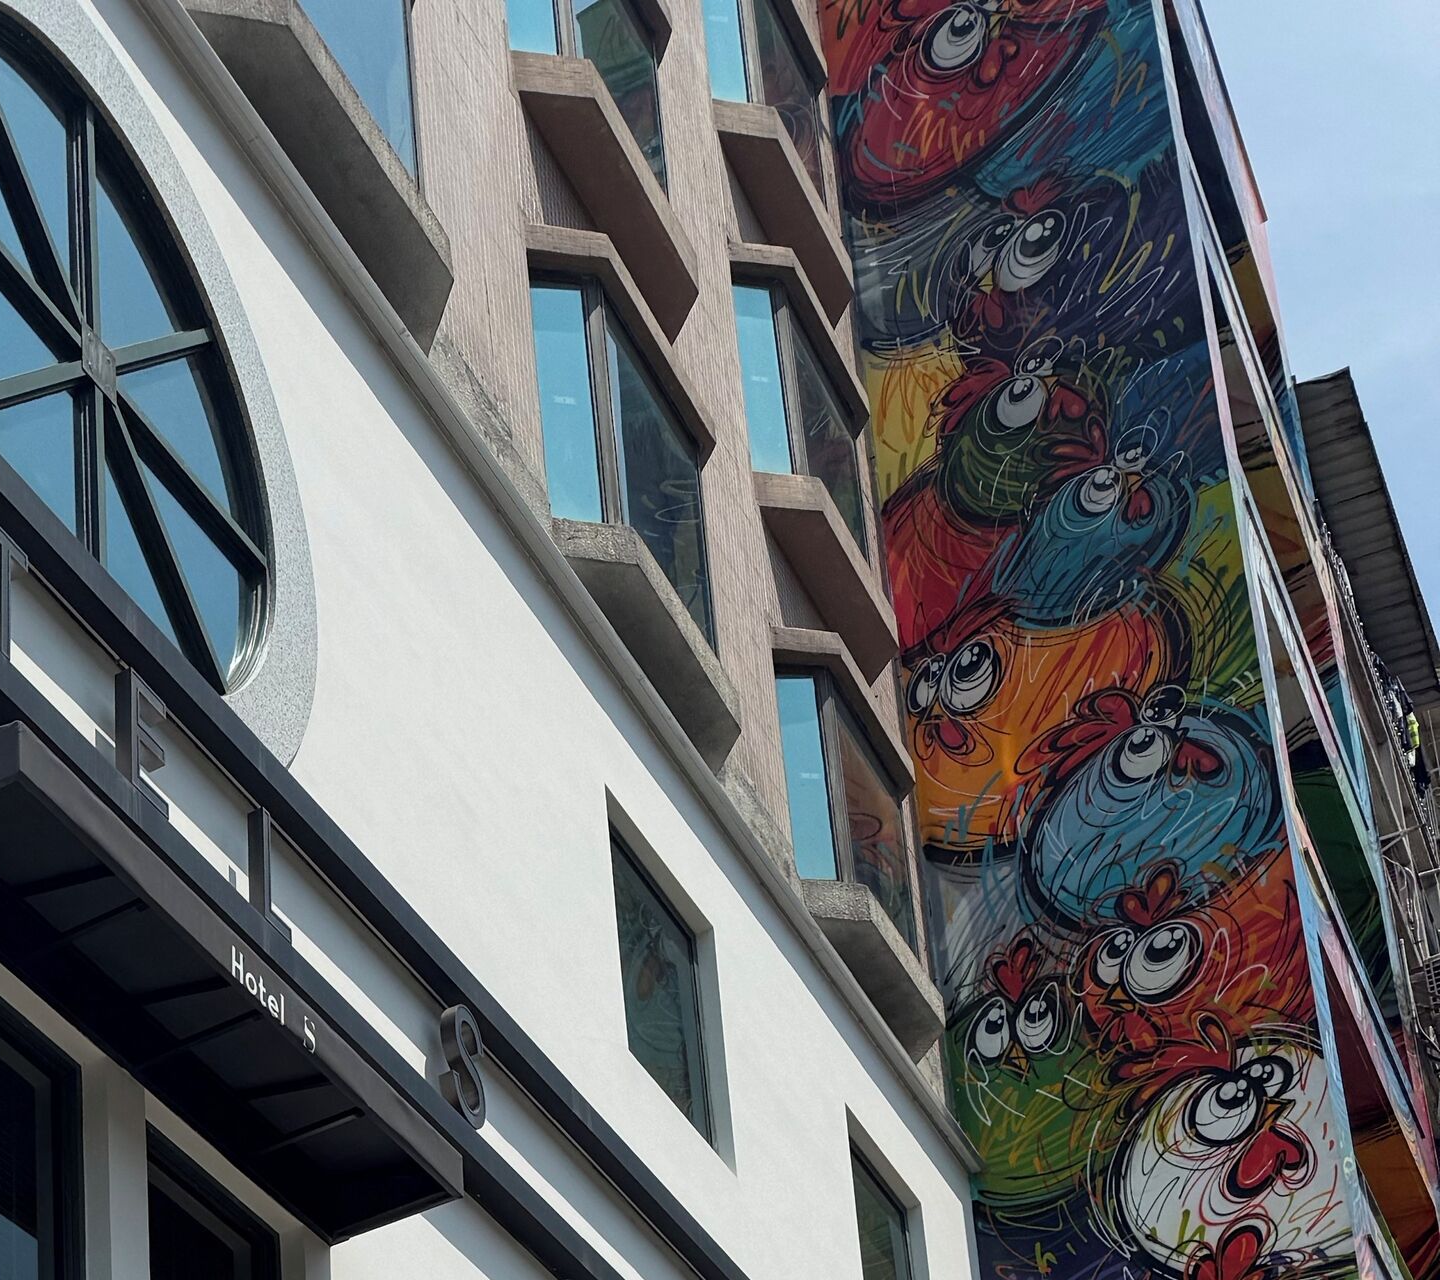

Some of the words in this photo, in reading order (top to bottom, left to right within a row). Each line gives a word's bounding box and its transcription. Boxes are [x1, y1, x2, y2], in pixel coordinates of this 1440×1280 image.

[231, 945, 285, 1026] Hotel
[303, 1015, 316, 1054] S
[439, 1004, 486, 1131] S
